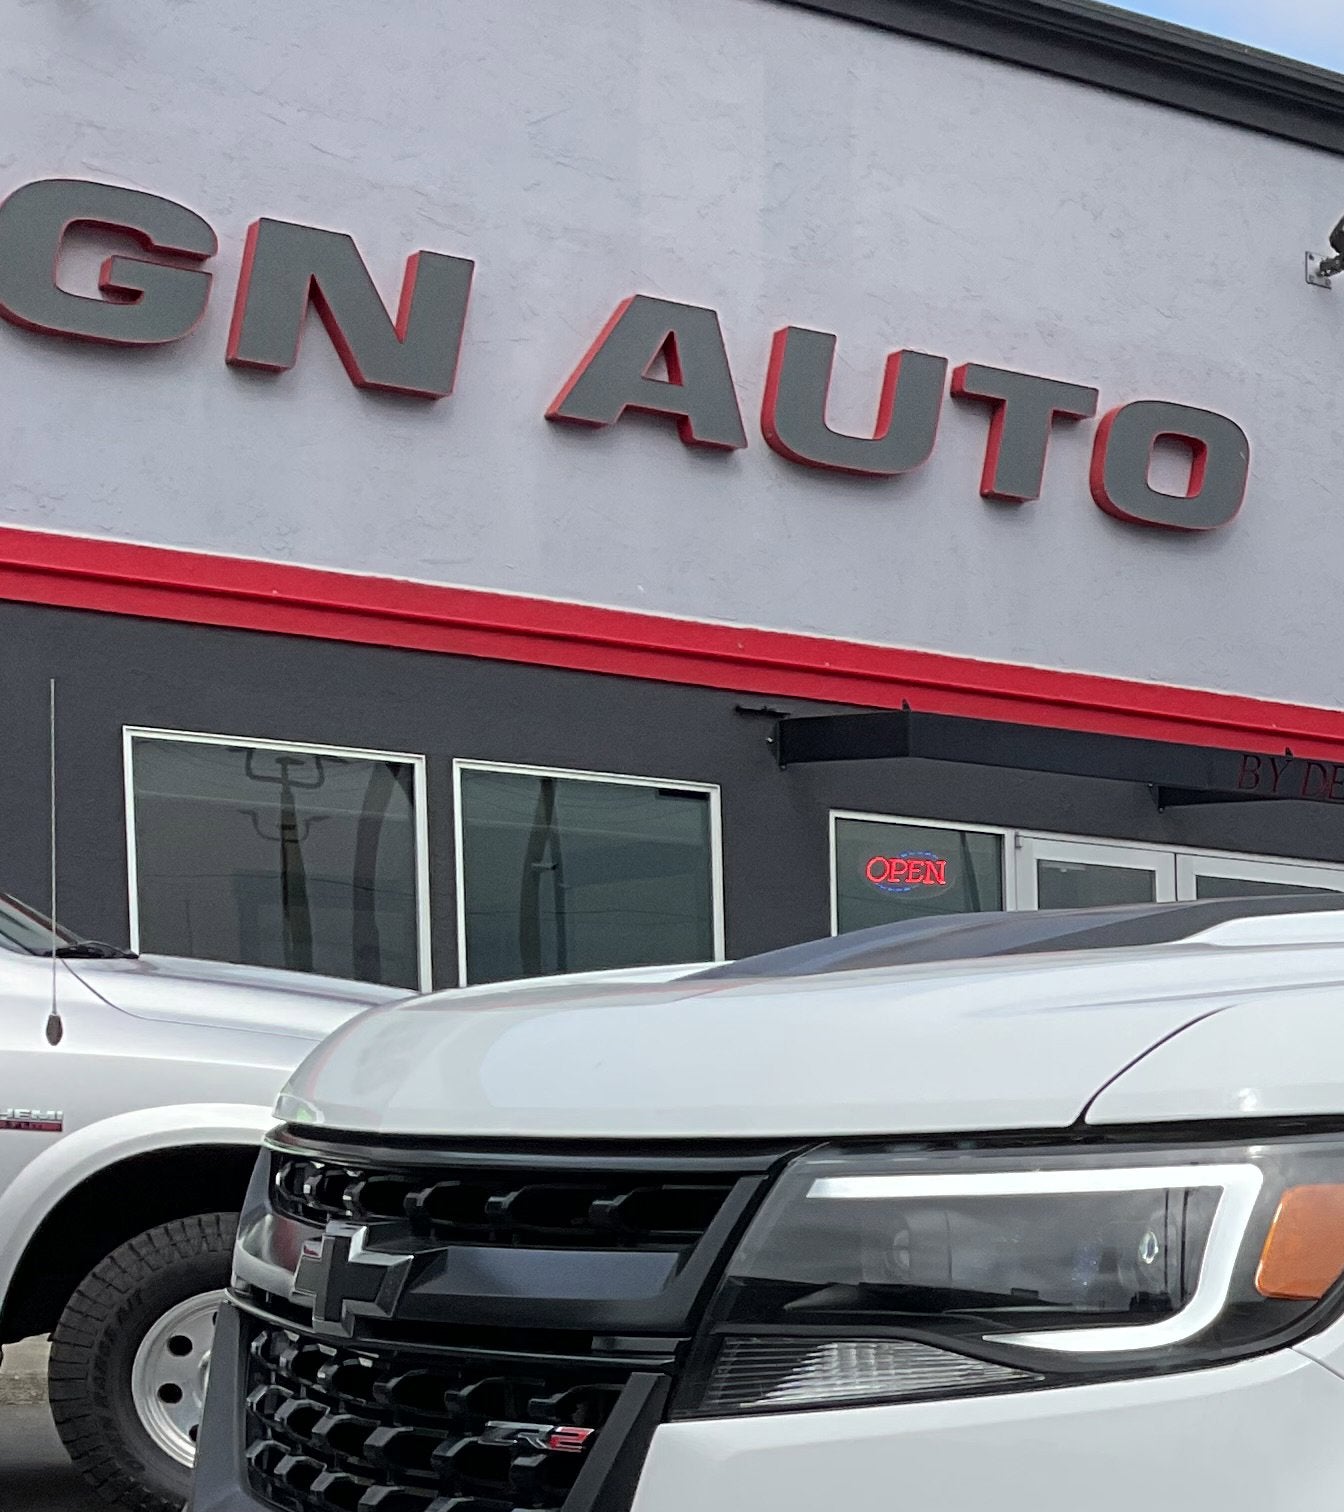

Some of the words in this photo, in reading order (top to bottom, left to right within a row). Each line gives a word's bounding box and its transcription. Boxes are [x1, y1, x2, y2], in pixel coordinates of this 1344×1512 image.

[0, 178, 475, 400] GN
[545, 293, 1251, 533] AUTO
[1238, 754, 1293, 793] BY
[866, 856, 947, 885] OPEN
[477, 1420, 595, 1453] ZR2
